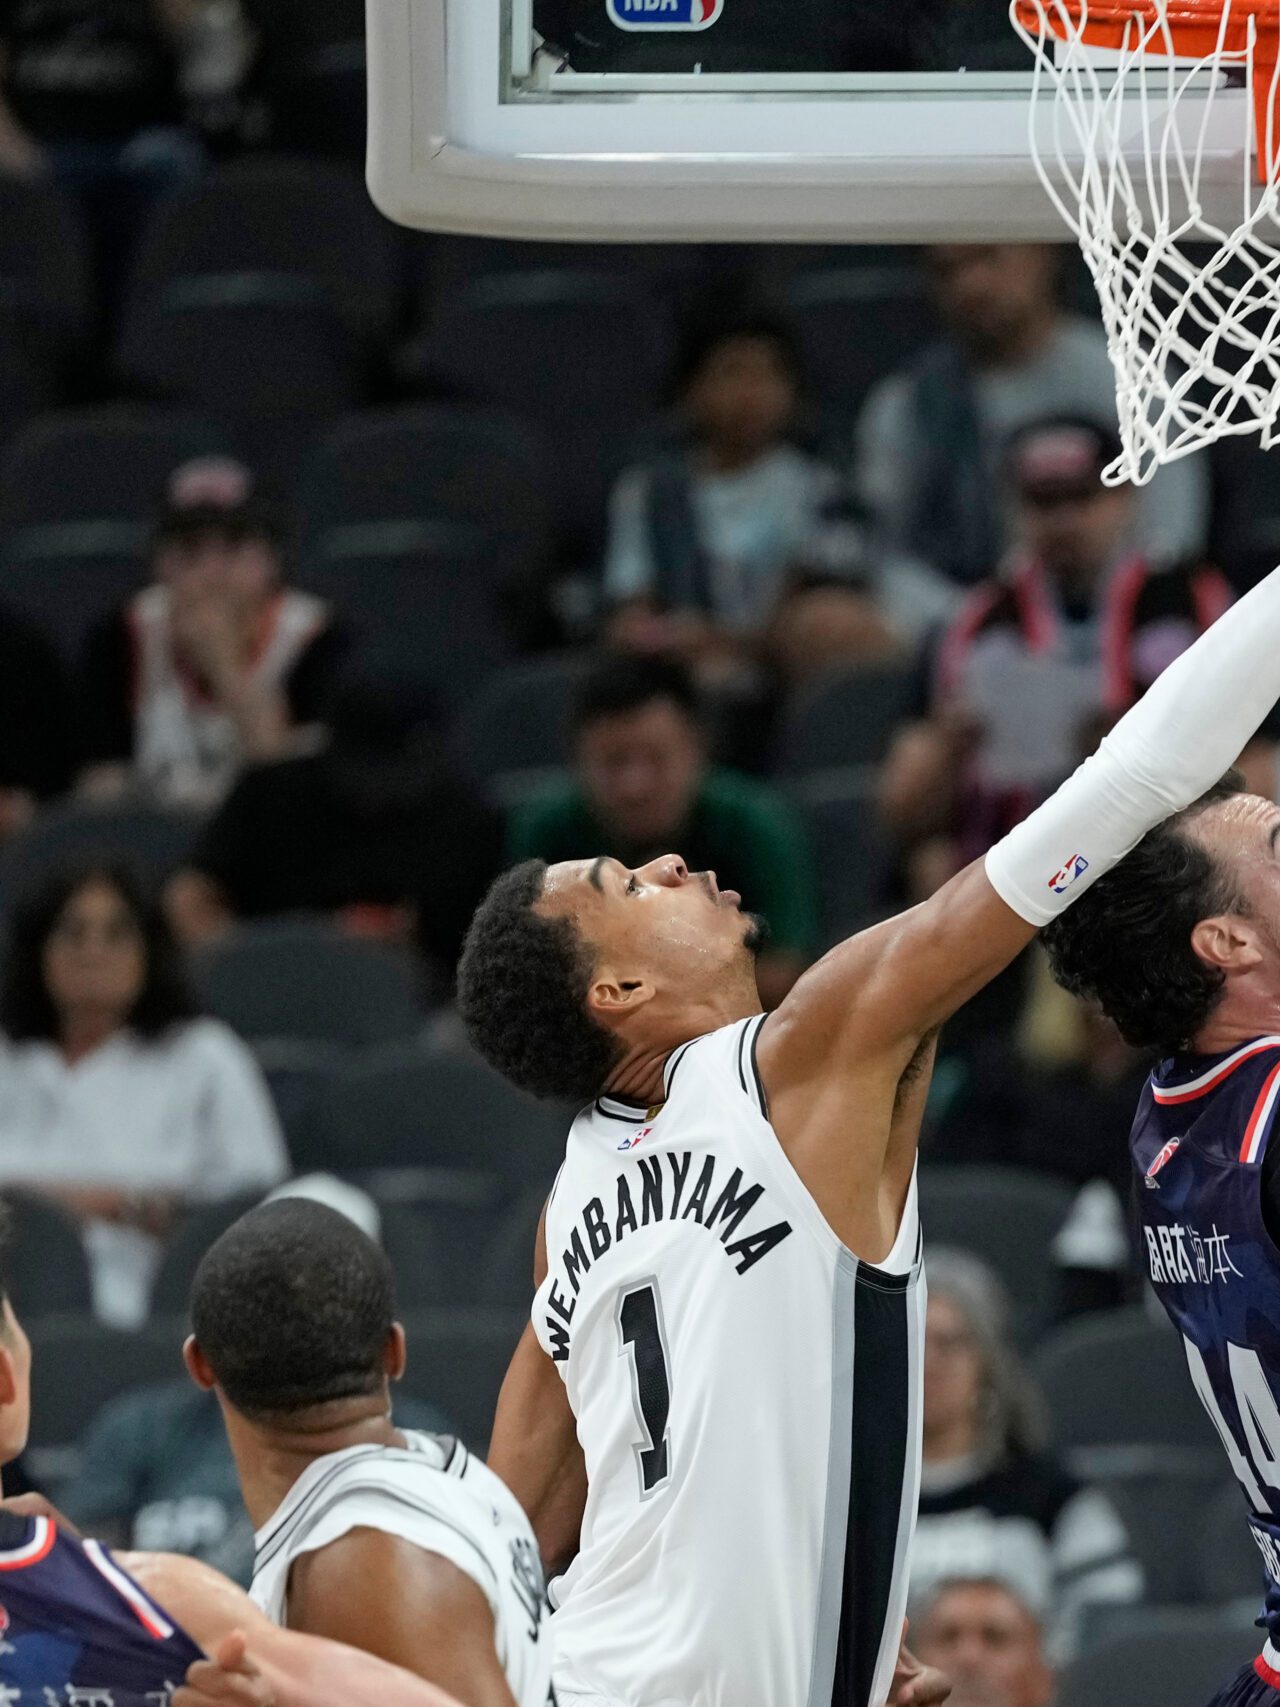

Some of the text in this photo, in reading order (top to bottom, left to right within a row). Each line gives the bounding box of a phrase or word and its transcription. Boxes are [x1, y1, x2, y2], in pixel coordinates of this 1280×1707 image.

[624, 0, 680, 12] NBA
[545, 1151, 793, 1361] WEMBANYAMA
[613, 1274, 674, 1503] 1
